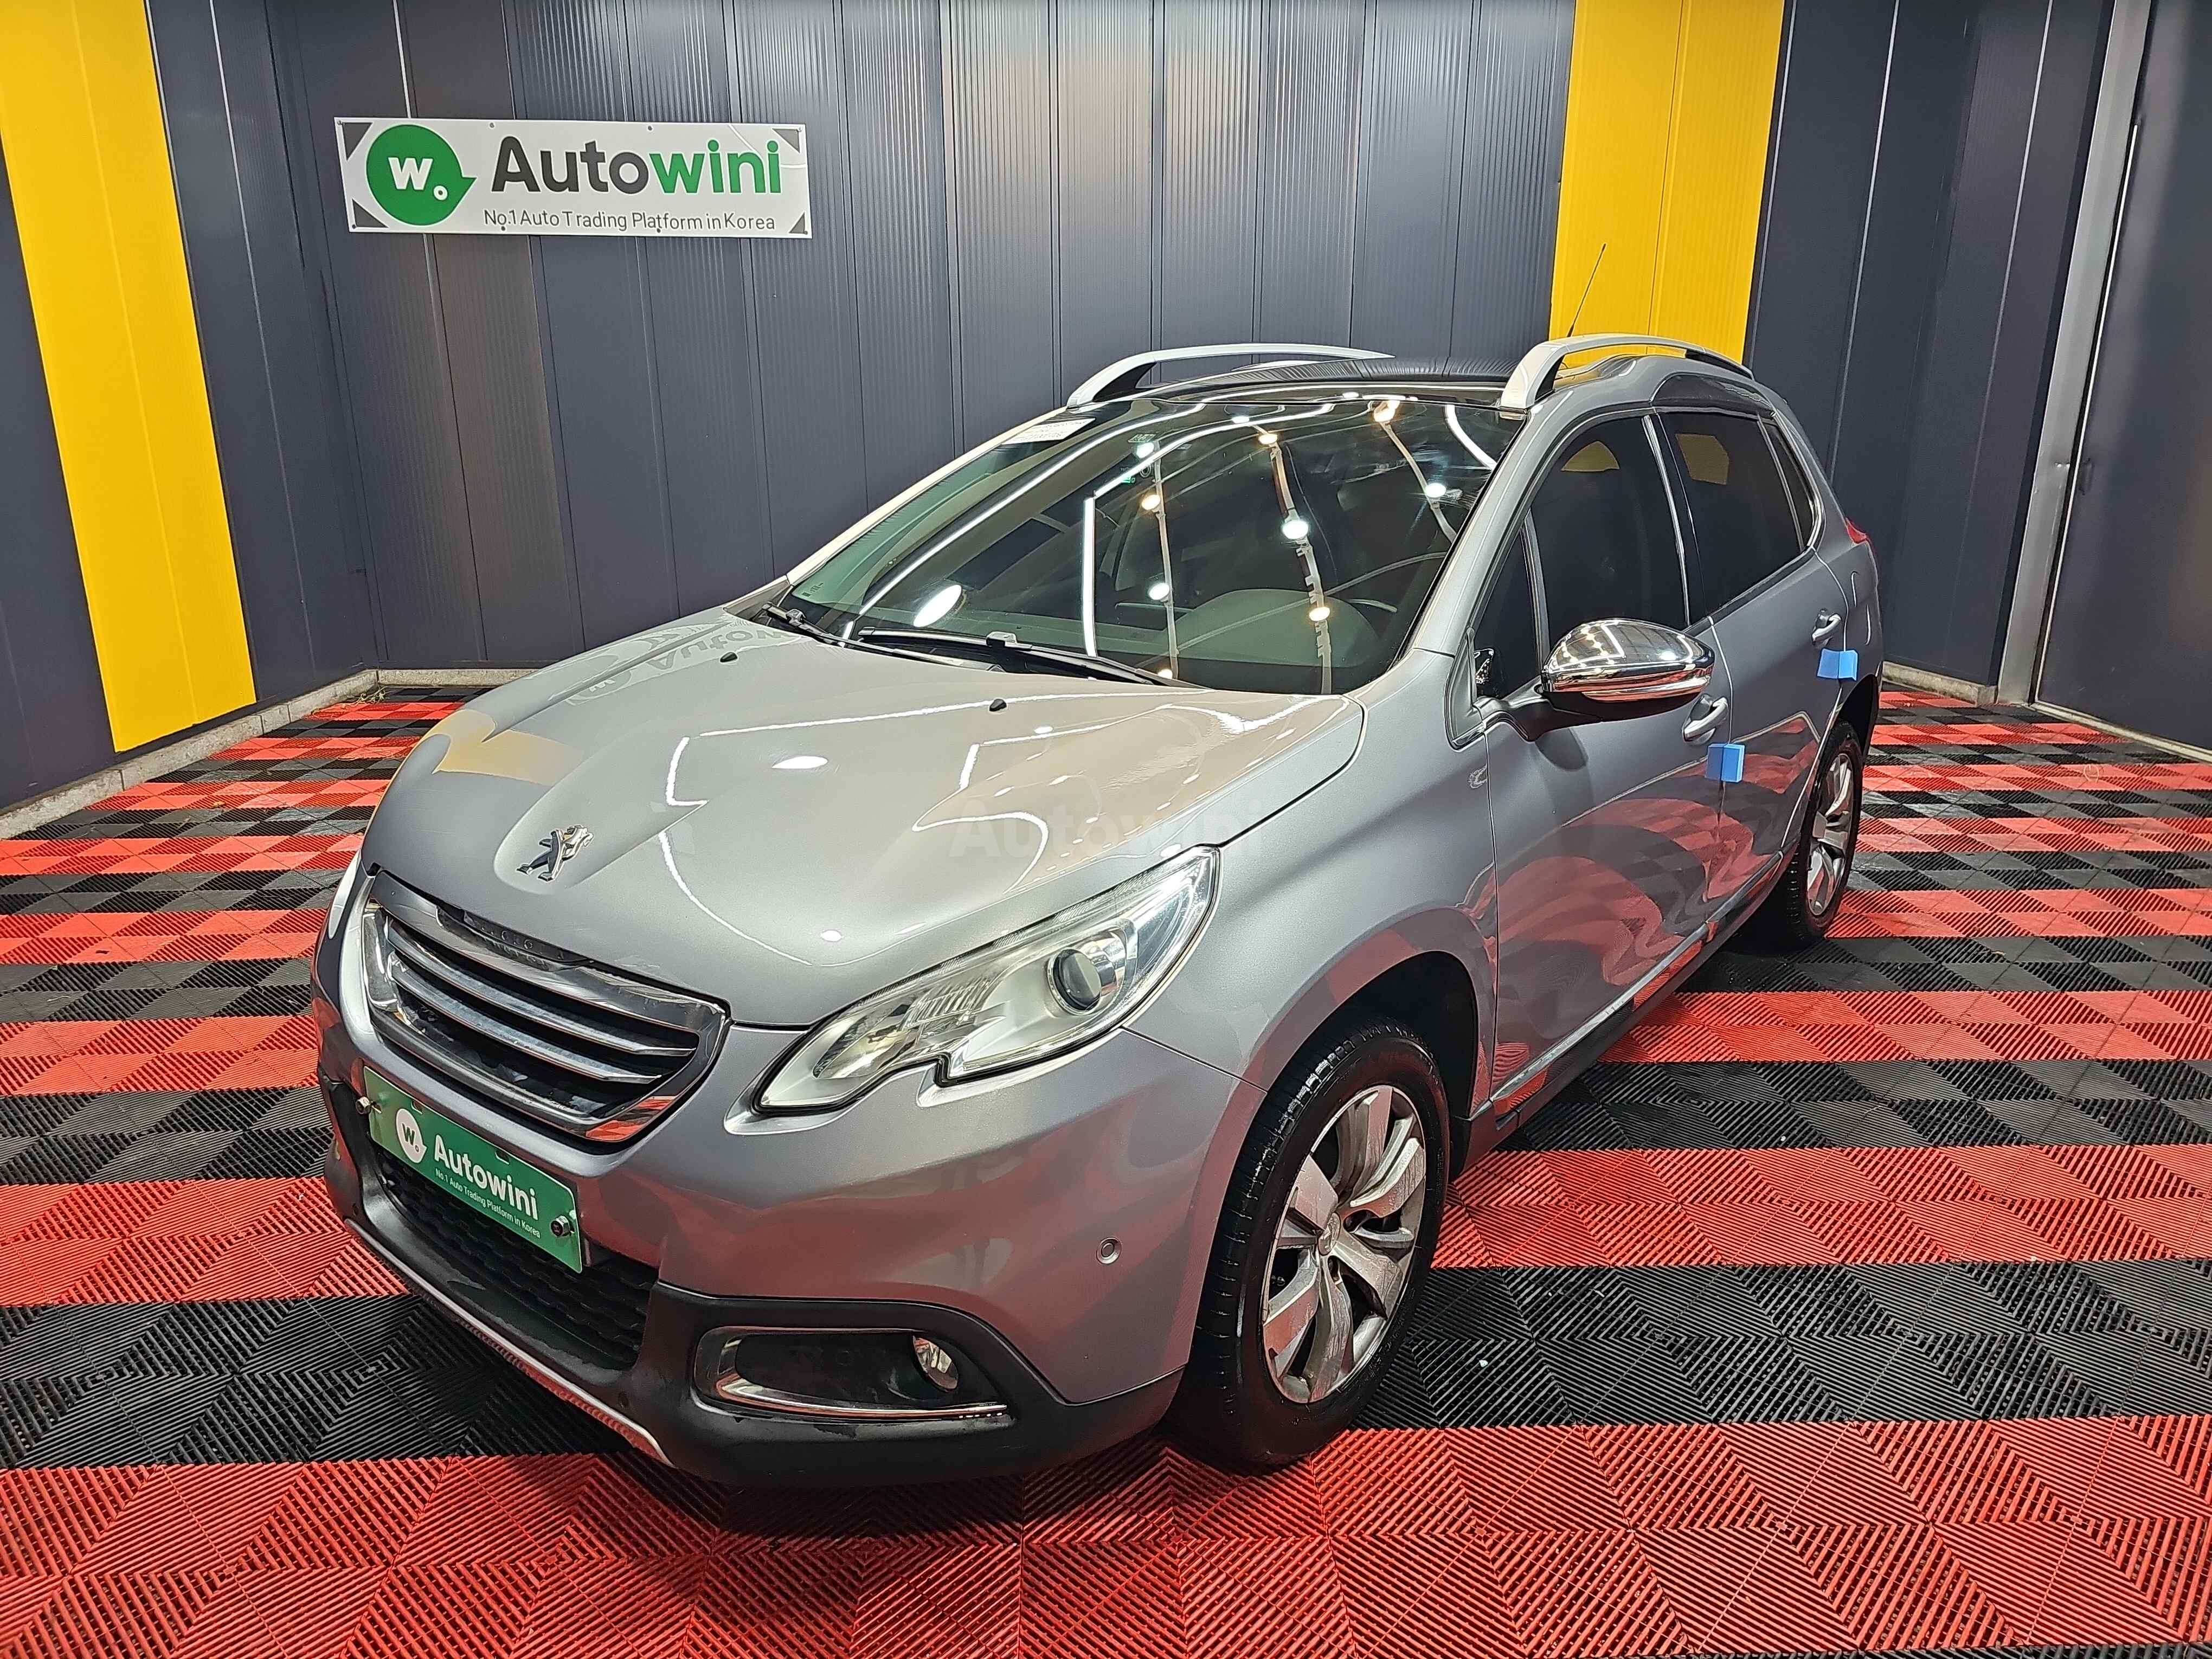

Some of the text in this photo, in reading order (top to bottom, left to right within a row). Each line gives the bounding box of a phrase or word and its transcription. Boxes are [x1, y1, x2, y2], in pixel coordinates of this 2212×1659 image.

[492, 136, 781, 194] Autowini
[520, 210, 560, 227] Auto
[562, 211, 627, 232] Trading
[632, 212, 703, 230] Platform
[706, 213, 722, 229] in
[724, 213, 775, 230] Korea
[434, 1134, 539, 1221] Autowini
[435, 1168, 541, 1239] No.1 Auto Trading Platform in Korea
